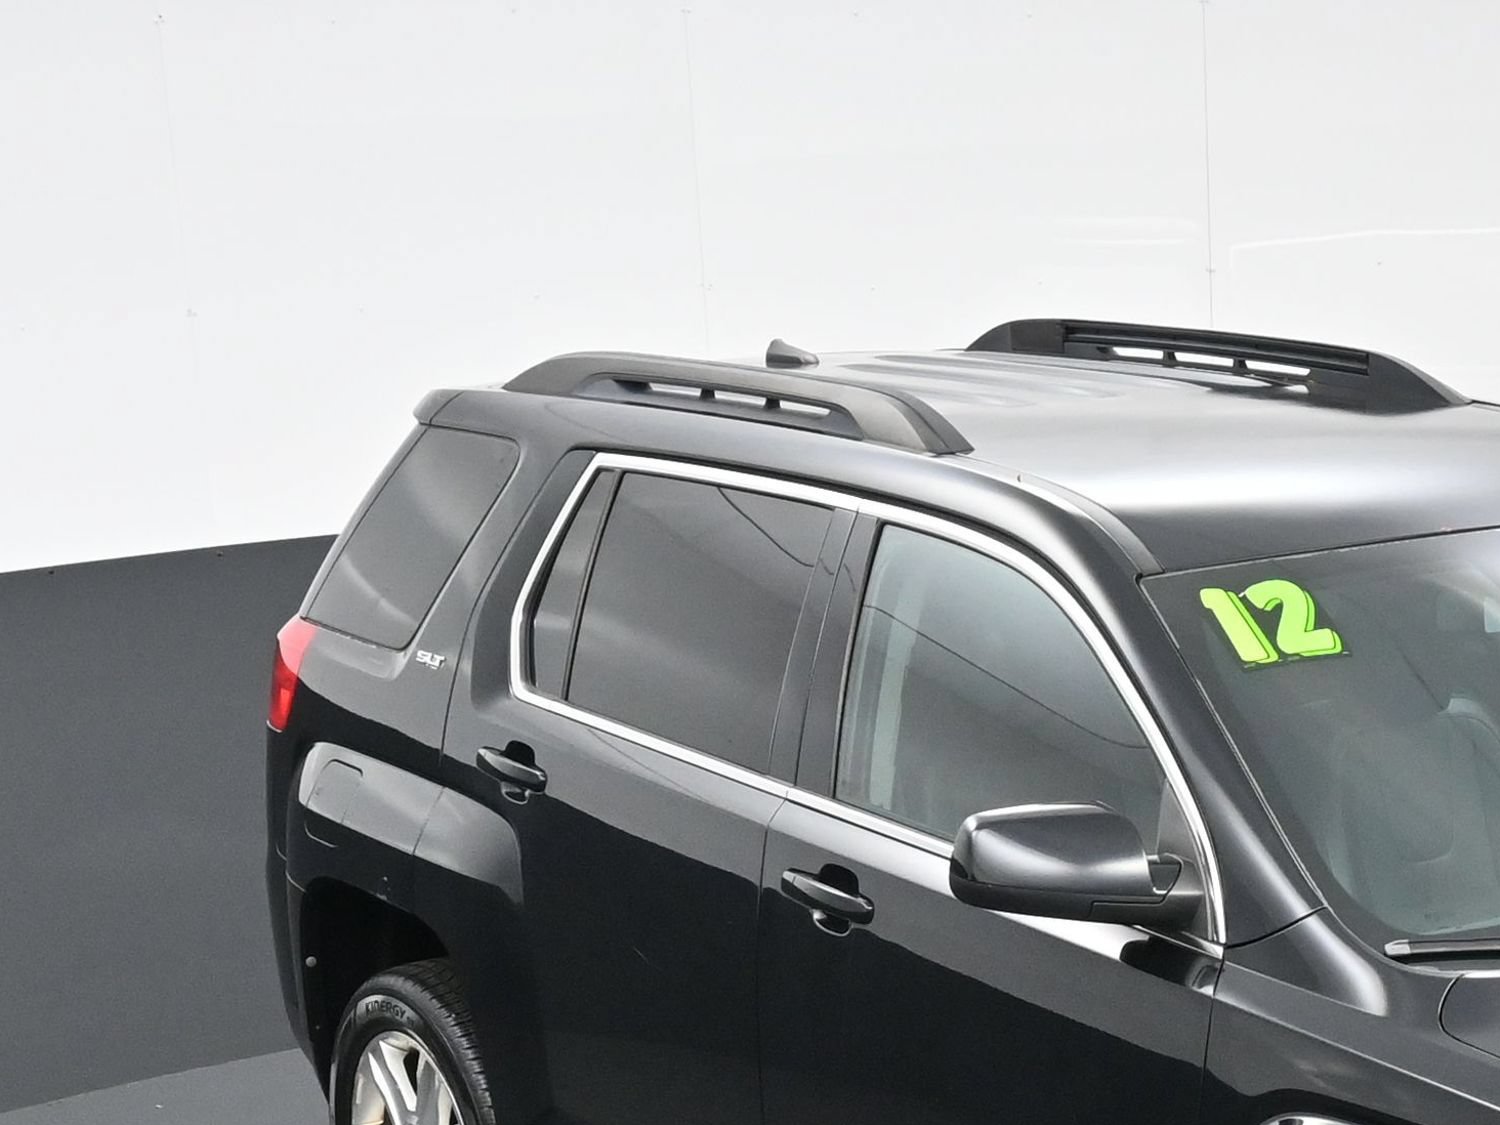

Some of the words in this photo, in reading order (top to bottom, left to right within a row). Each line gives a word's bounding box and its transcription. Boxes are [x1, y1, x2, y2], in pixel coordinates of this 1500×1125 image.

[1200, 579, 1343, 663] 12
[415, 650, 446, 669] SLT
[365, 1000, 406, 1019] KINERGY
